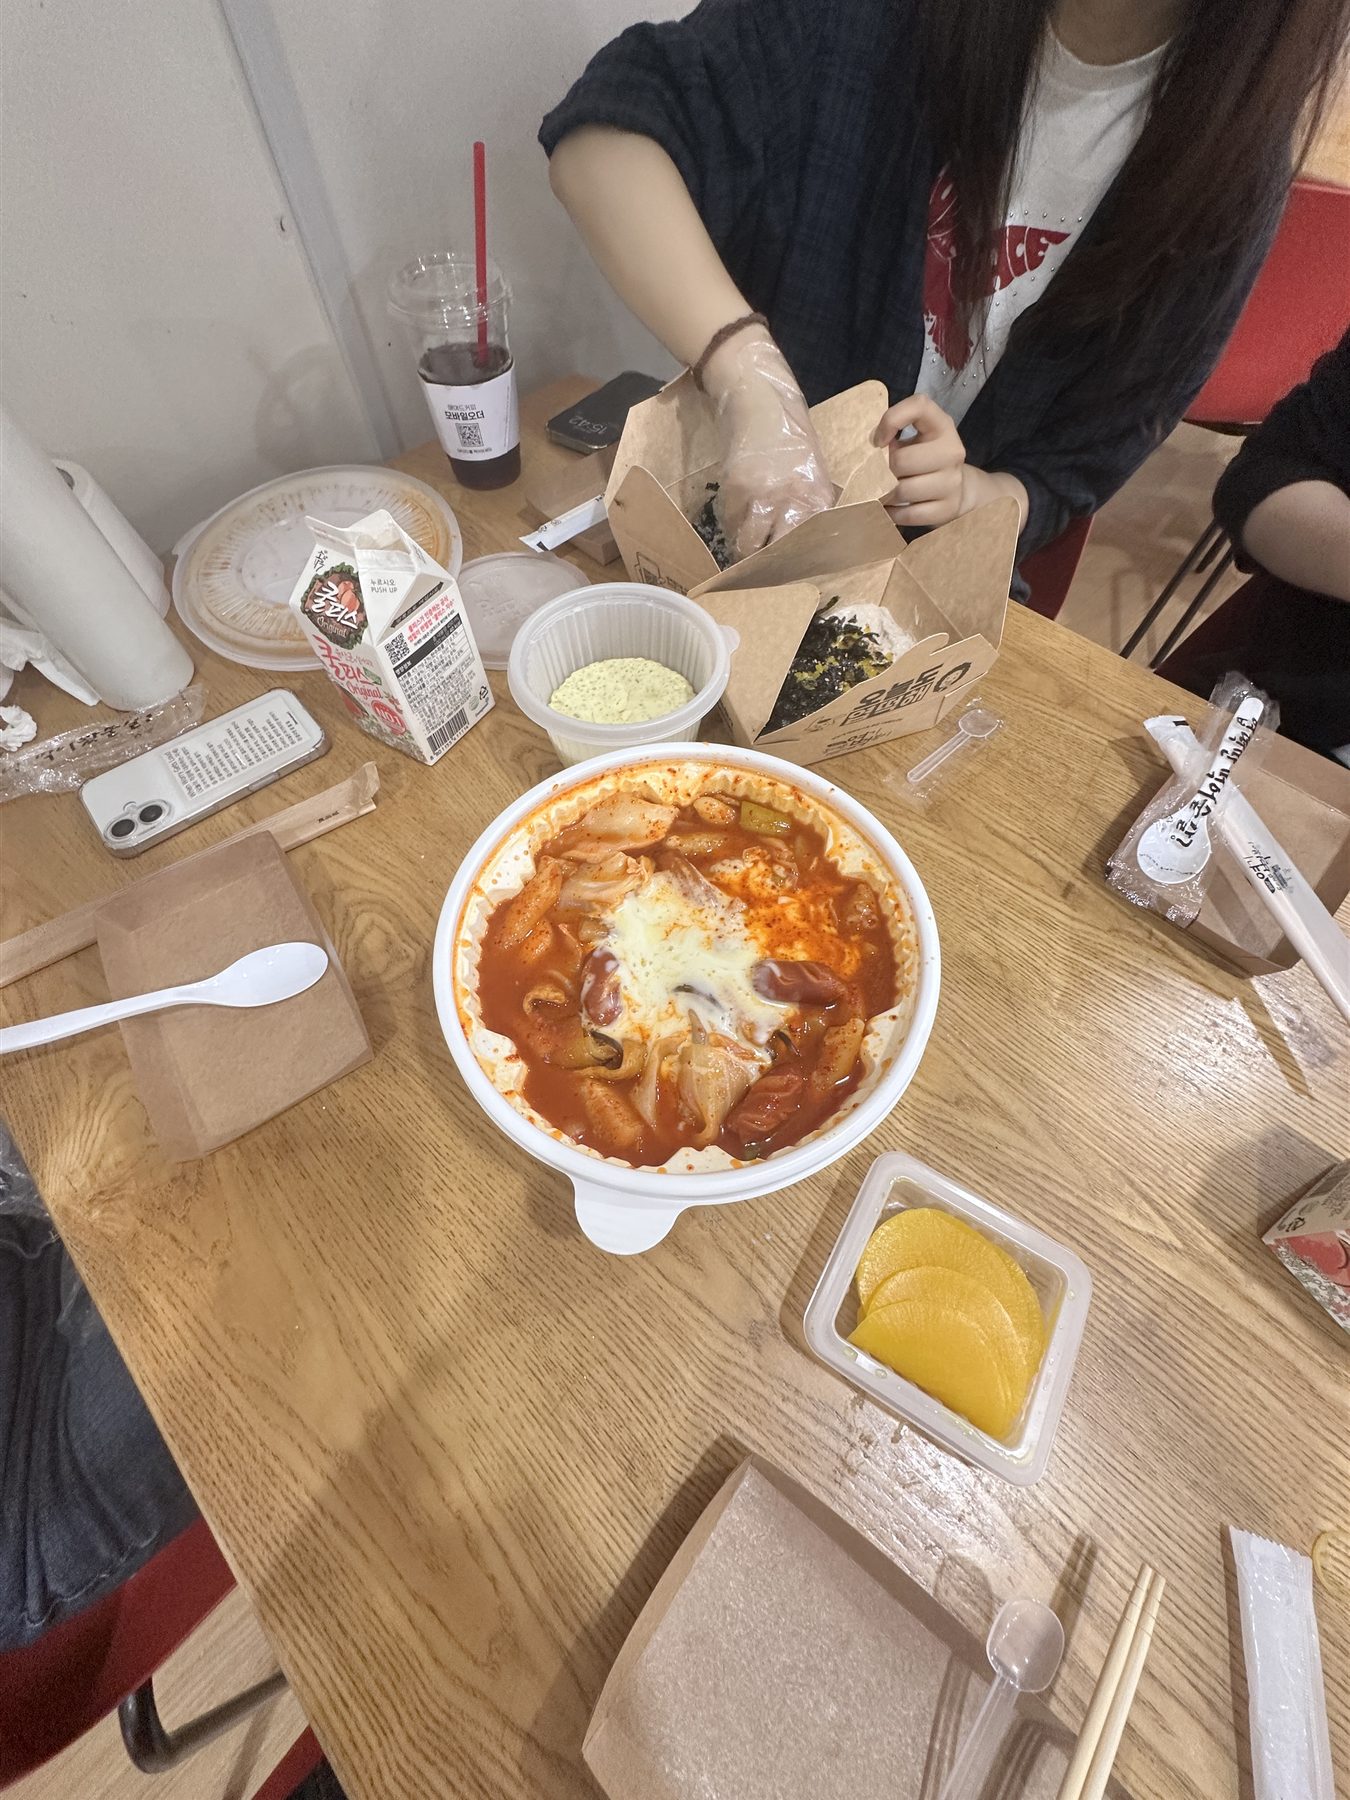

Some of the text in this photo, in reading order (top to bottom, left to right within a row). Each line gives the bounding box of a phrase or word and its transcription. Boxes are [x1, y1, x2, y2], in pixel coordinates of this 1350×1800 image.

[444, 410, 485, 421] 모바일오더
[568, 414, 608, 434] 15:42
[370, 578, 397, 587] 누르시오
[370, 586, 389, 594] PUSH
[311, 581, 358, 630] 쿨피스
[316, 616, 348, 639] Original
[345, 681, 383, 700] Original
[853, 662, 944, 710] 오늘도
